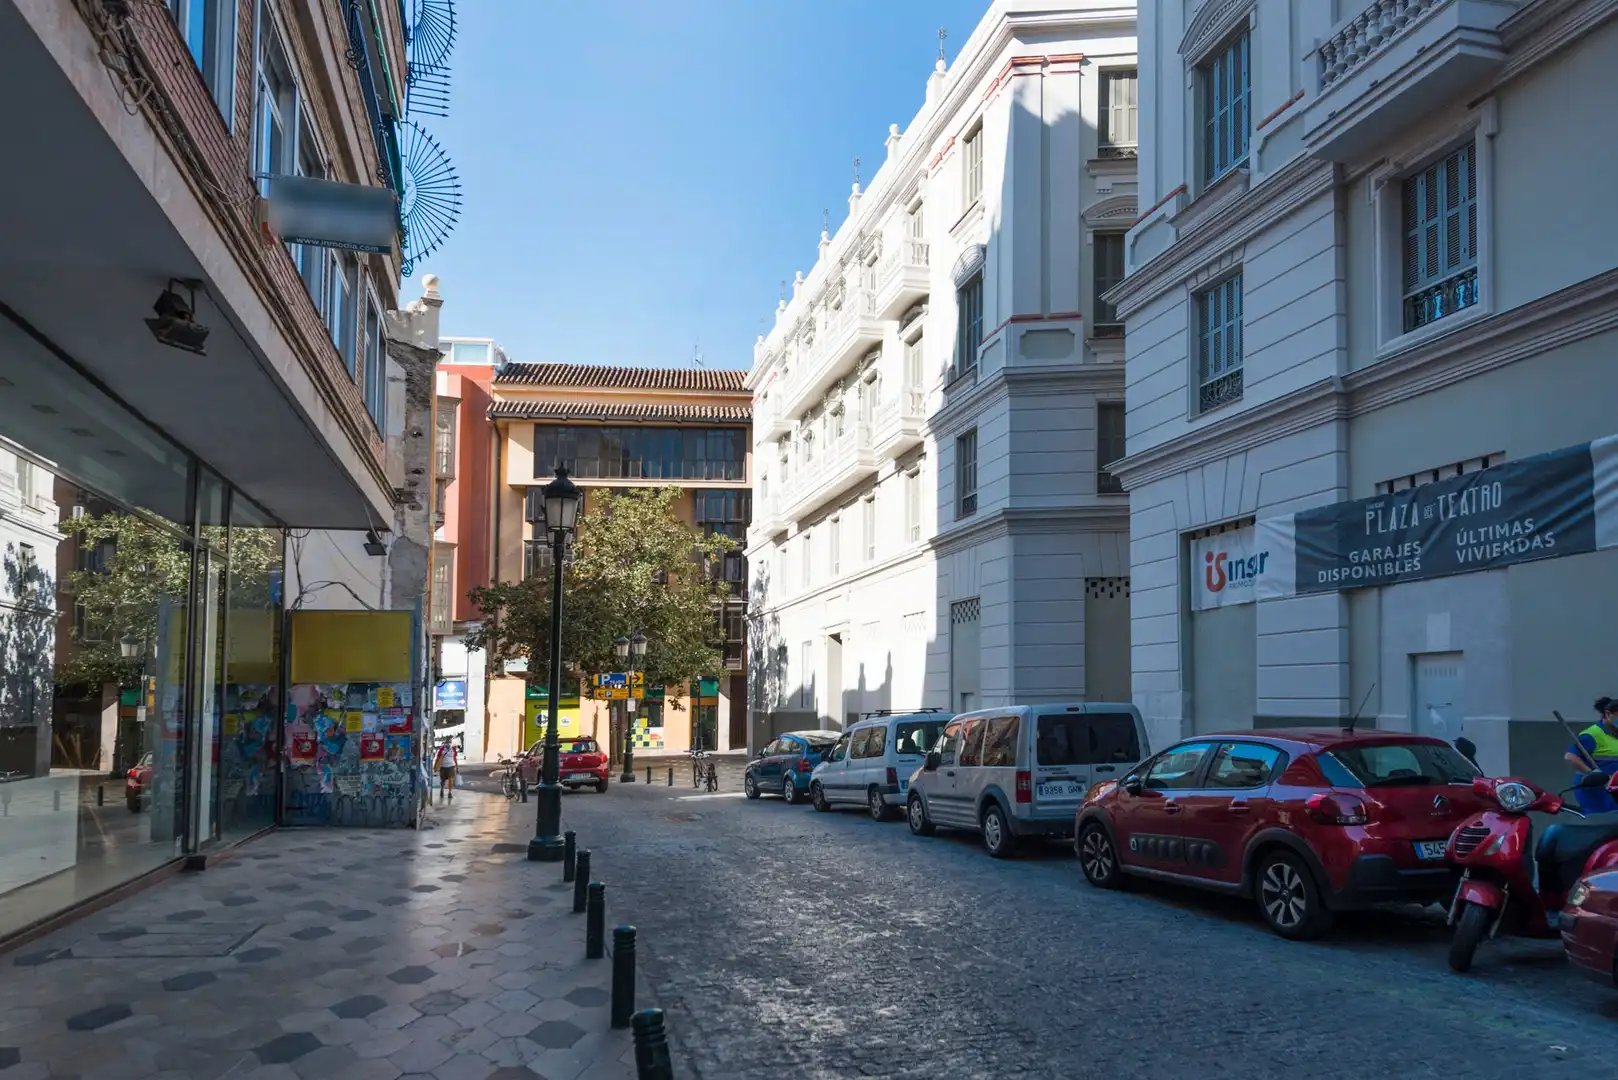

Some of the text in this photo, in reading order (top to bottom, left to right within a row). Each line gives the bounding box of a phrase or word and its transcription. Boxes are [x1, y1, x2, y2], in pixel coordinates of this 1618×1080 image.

[1365, 502, 1419, 536] PLAZA
[1437, 481, 1502, 520] TEATRO
[1456, 518, 1534, 546] ÚLTIMAS
[1349, 541, 1421, 563] GARAJES
[1456, 532, 1555, 563] VIVIENDAS
[1318, 557, 1421, 583] DISPONIBLES
